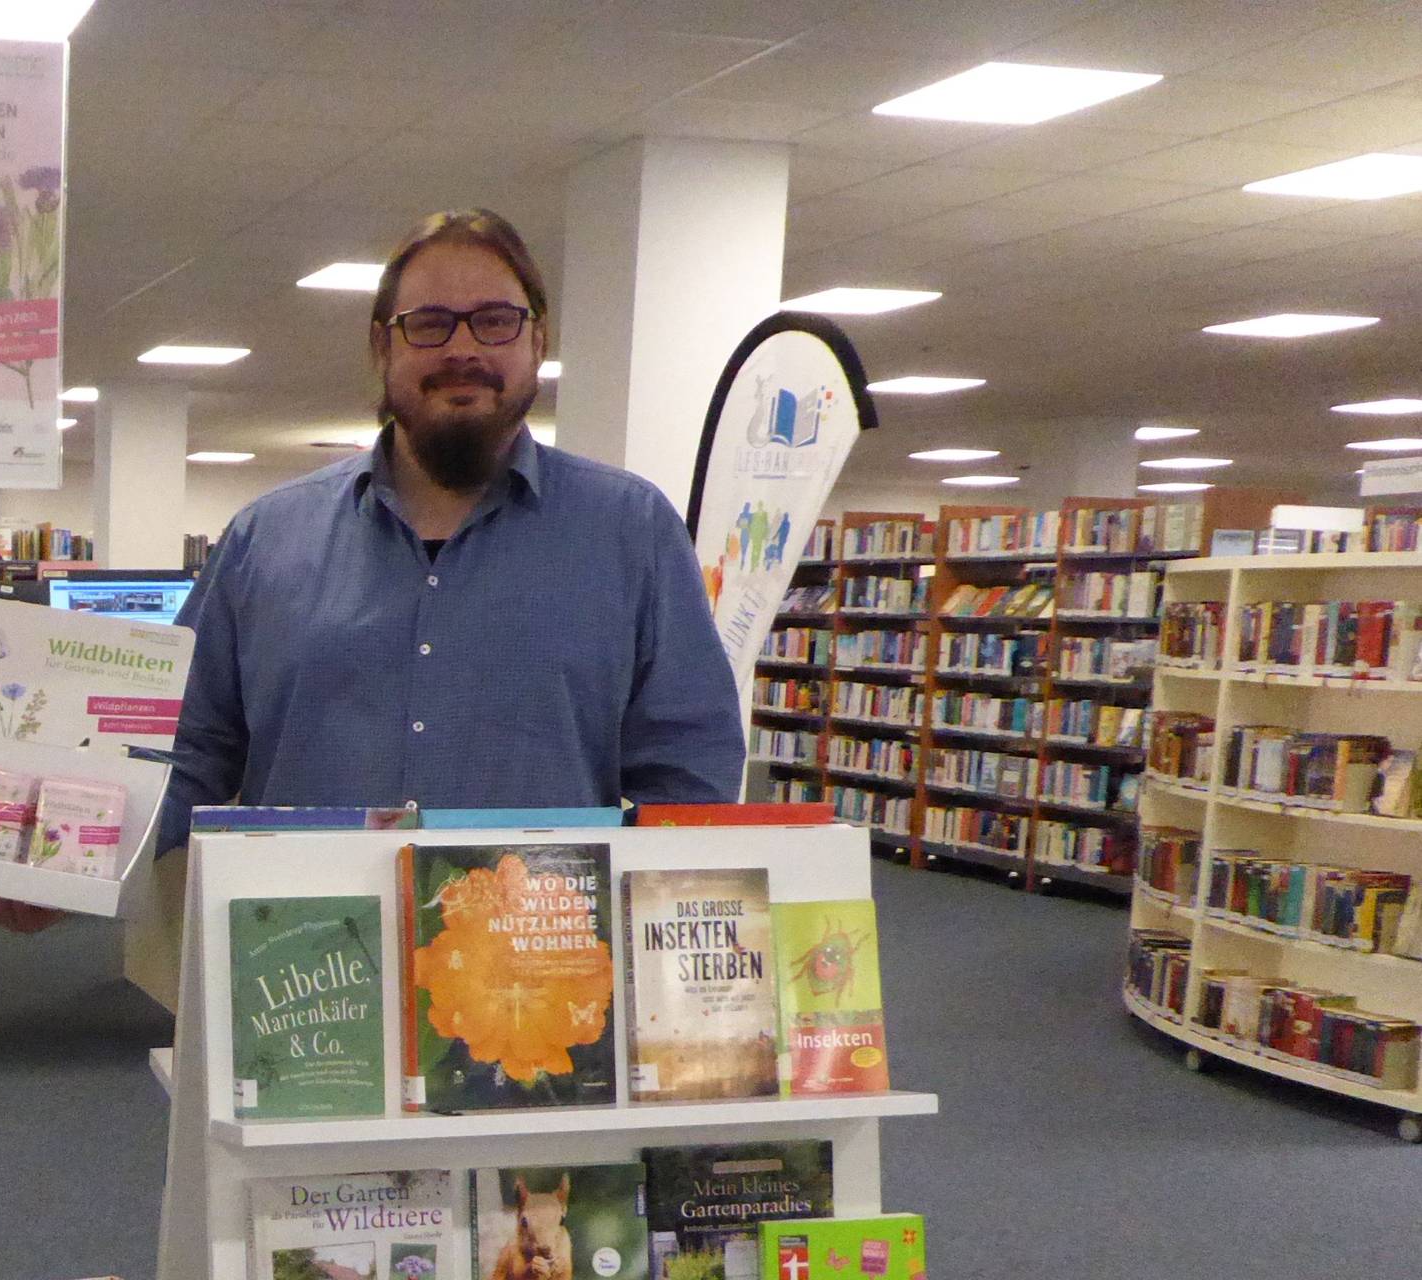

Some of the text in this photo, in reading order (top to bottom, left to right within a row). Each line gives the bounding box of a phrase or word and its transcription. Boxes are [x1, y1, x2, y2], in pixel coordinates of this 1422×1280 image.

[48, 638, 175, 673] Wildblüten
[64, 660, 105, 676] Garten
[106, 669, 130, 680] und
[525, 875, 596, 892] WO DIE
[522, 895, 597, 912] WILDEN
[677, 900, 744, 918] DAS GROSSE
[488, 913, 598, 933] NÜTZLINGE
[511, 934, 598, 953] WOHNEN
[644, 920, 738, 951] INSEKTEN
[678, 951, 764, 982] STERBEN
[251, 997, 368, 1038] Marienkäfer
[290, 1031, 345, 1058] & Co.
[797, 1029, 873, 1049] Insekten
[291, 1183, 410, 1206] Der Garten
[693, 1175, 801, 1197] Mein kleines
[324, 1204, 443, 1232] Wildtiere
[681, 1196, 813, 1221] Gartenparadies
